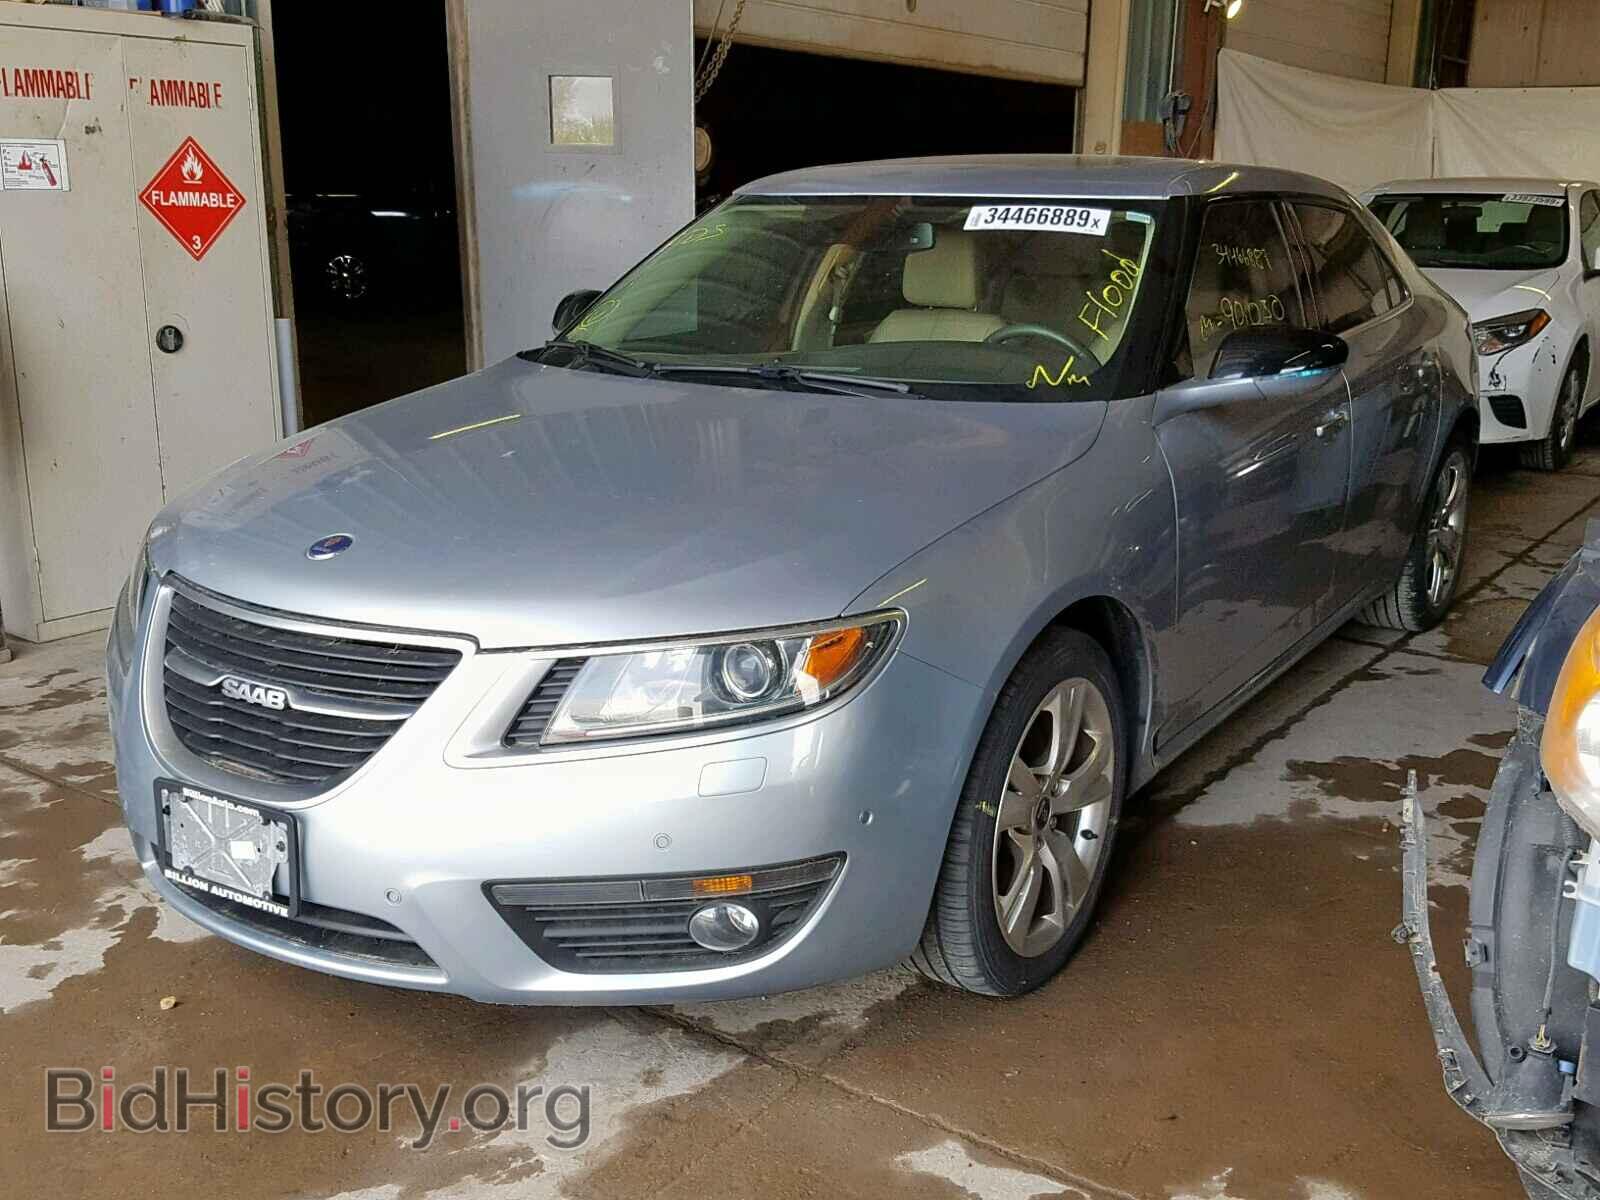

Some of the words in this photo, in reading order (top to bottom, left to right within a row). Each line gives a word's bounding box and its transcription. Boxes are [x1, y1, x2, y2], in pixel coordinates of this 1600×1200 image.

[151, 191, 235, 208] FLAMMABLE
[192, 235, 202, 250] 3
[221, 678, 286, 710] SAAB
[164, 869, 209, 892] BILLION
[210, 885, 289, 918] AUTOMOTIVE
